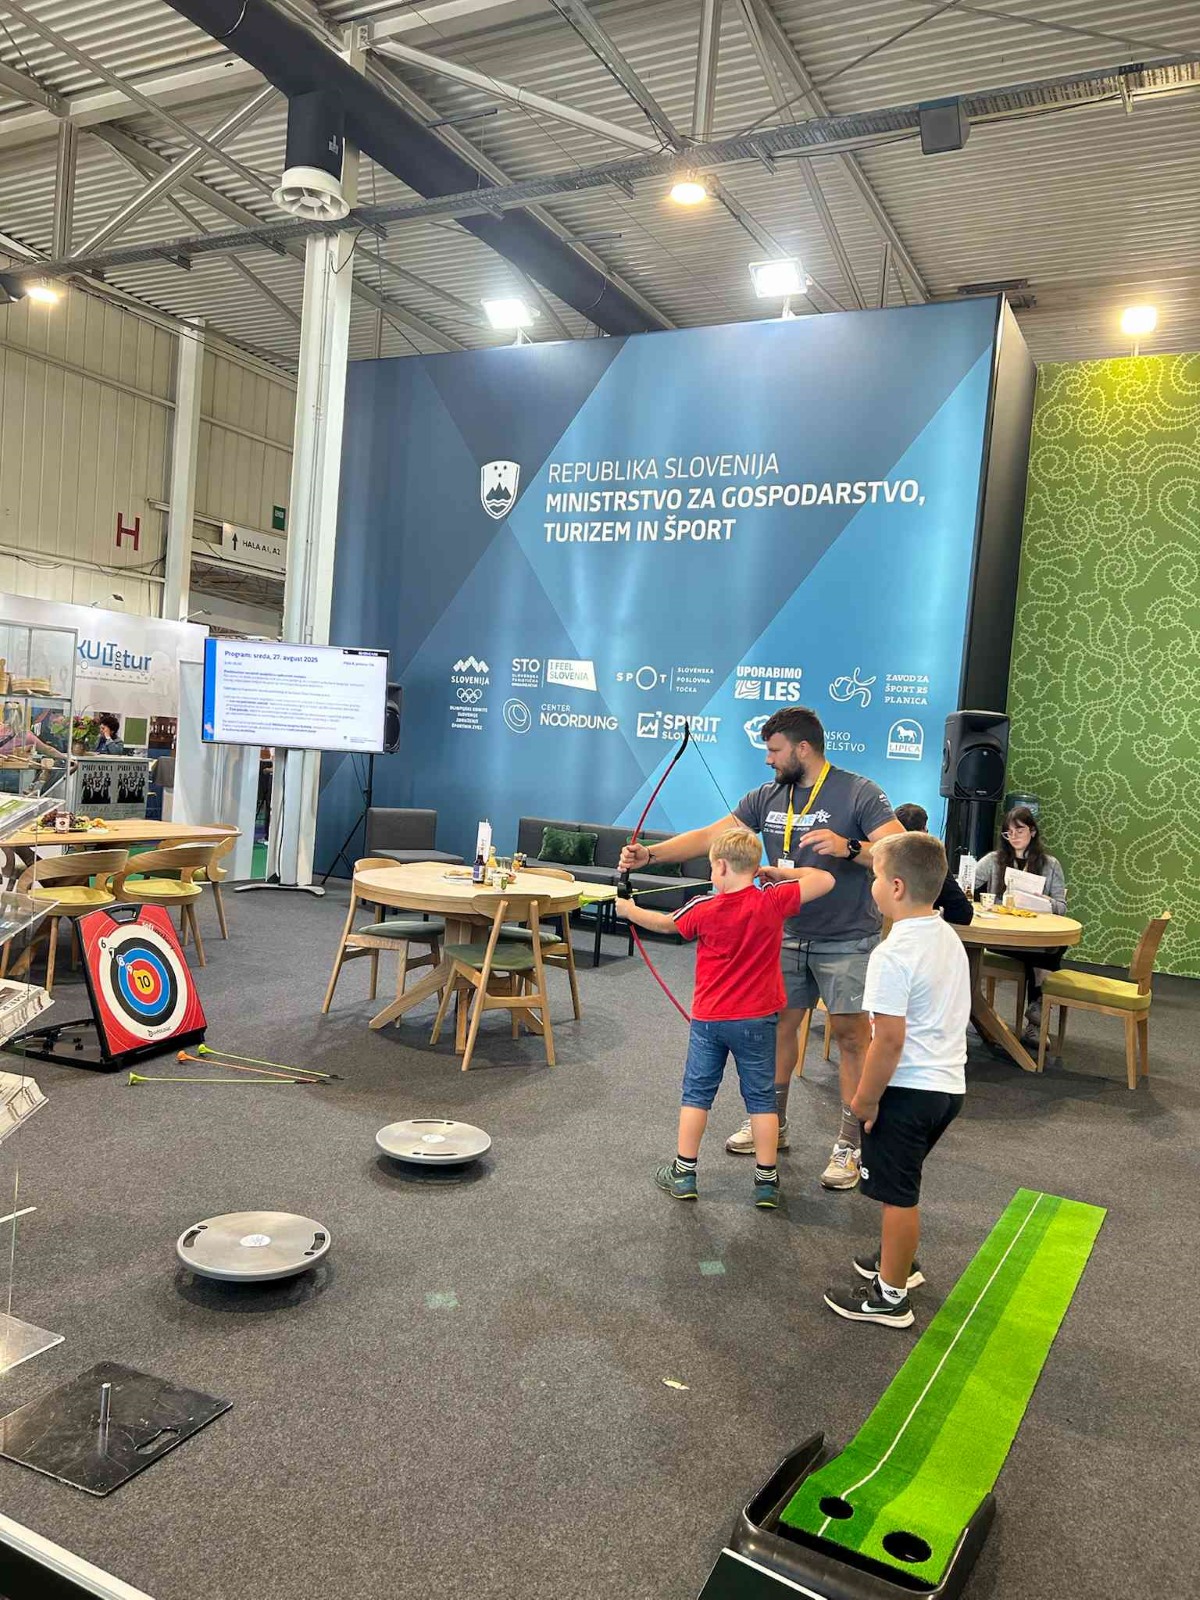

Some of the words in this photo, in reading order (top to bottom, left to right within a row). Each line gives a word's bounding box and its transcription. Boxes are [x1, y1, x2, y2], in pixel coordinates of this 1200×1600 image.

[548, 459, 658, 483] REPUBLIKA
[664, 453, 779, 480] SLOVENIJA
[546, 488, 683, 513] MINISTRSTVO
[687, 487, 716, 509] ZA
[721, 479, 927, 508] GOSPODARSTVO,
[116, 512, 140, 551] H
[543, 521, 631, 543] TURIZEM
[636, 520, 658, 541] IN
[663, 515, 737, 541] ŠPORT
[242, 540, 261, 551] HALA
[224, 650, 252, 659] Program:
[512, 658, 540, 673] STO
[550, 662, 554, 671] I
[555, 662, 573, 671] FEEL
[549, 671, 589, 681] SLOVENIA
[736, 666, 802, 679] UPORABIMO
[451, 676, 490, 686] SLOVENIJA
[616, 666, 667, 690] SPOT
[886, 674, 916, 682] ZAVOD
[917, 675, 929, 683] ZA
[676, 685, 697, 693] TOČKA
[764, 681, 800, 701] LES
[885, 684, 914, 693] ŠPORT
[916, 686, 929, 694] RS
[884, 696, 928, 705] PLANICA
[541, 703, 571, 712] CENTER
[540, 712, 618, 731] NOORDUNG
[663, 714, 722, 732] SPIRIT
[889, 743, 921, 753] LIPICA
[101, 939, 107, 949] 6
[109, 948, 115, 959] 7
[118, 956, 125, 966] 8
[127, 965, 133, 975] 9
[137, 975, 151, 988] 10
